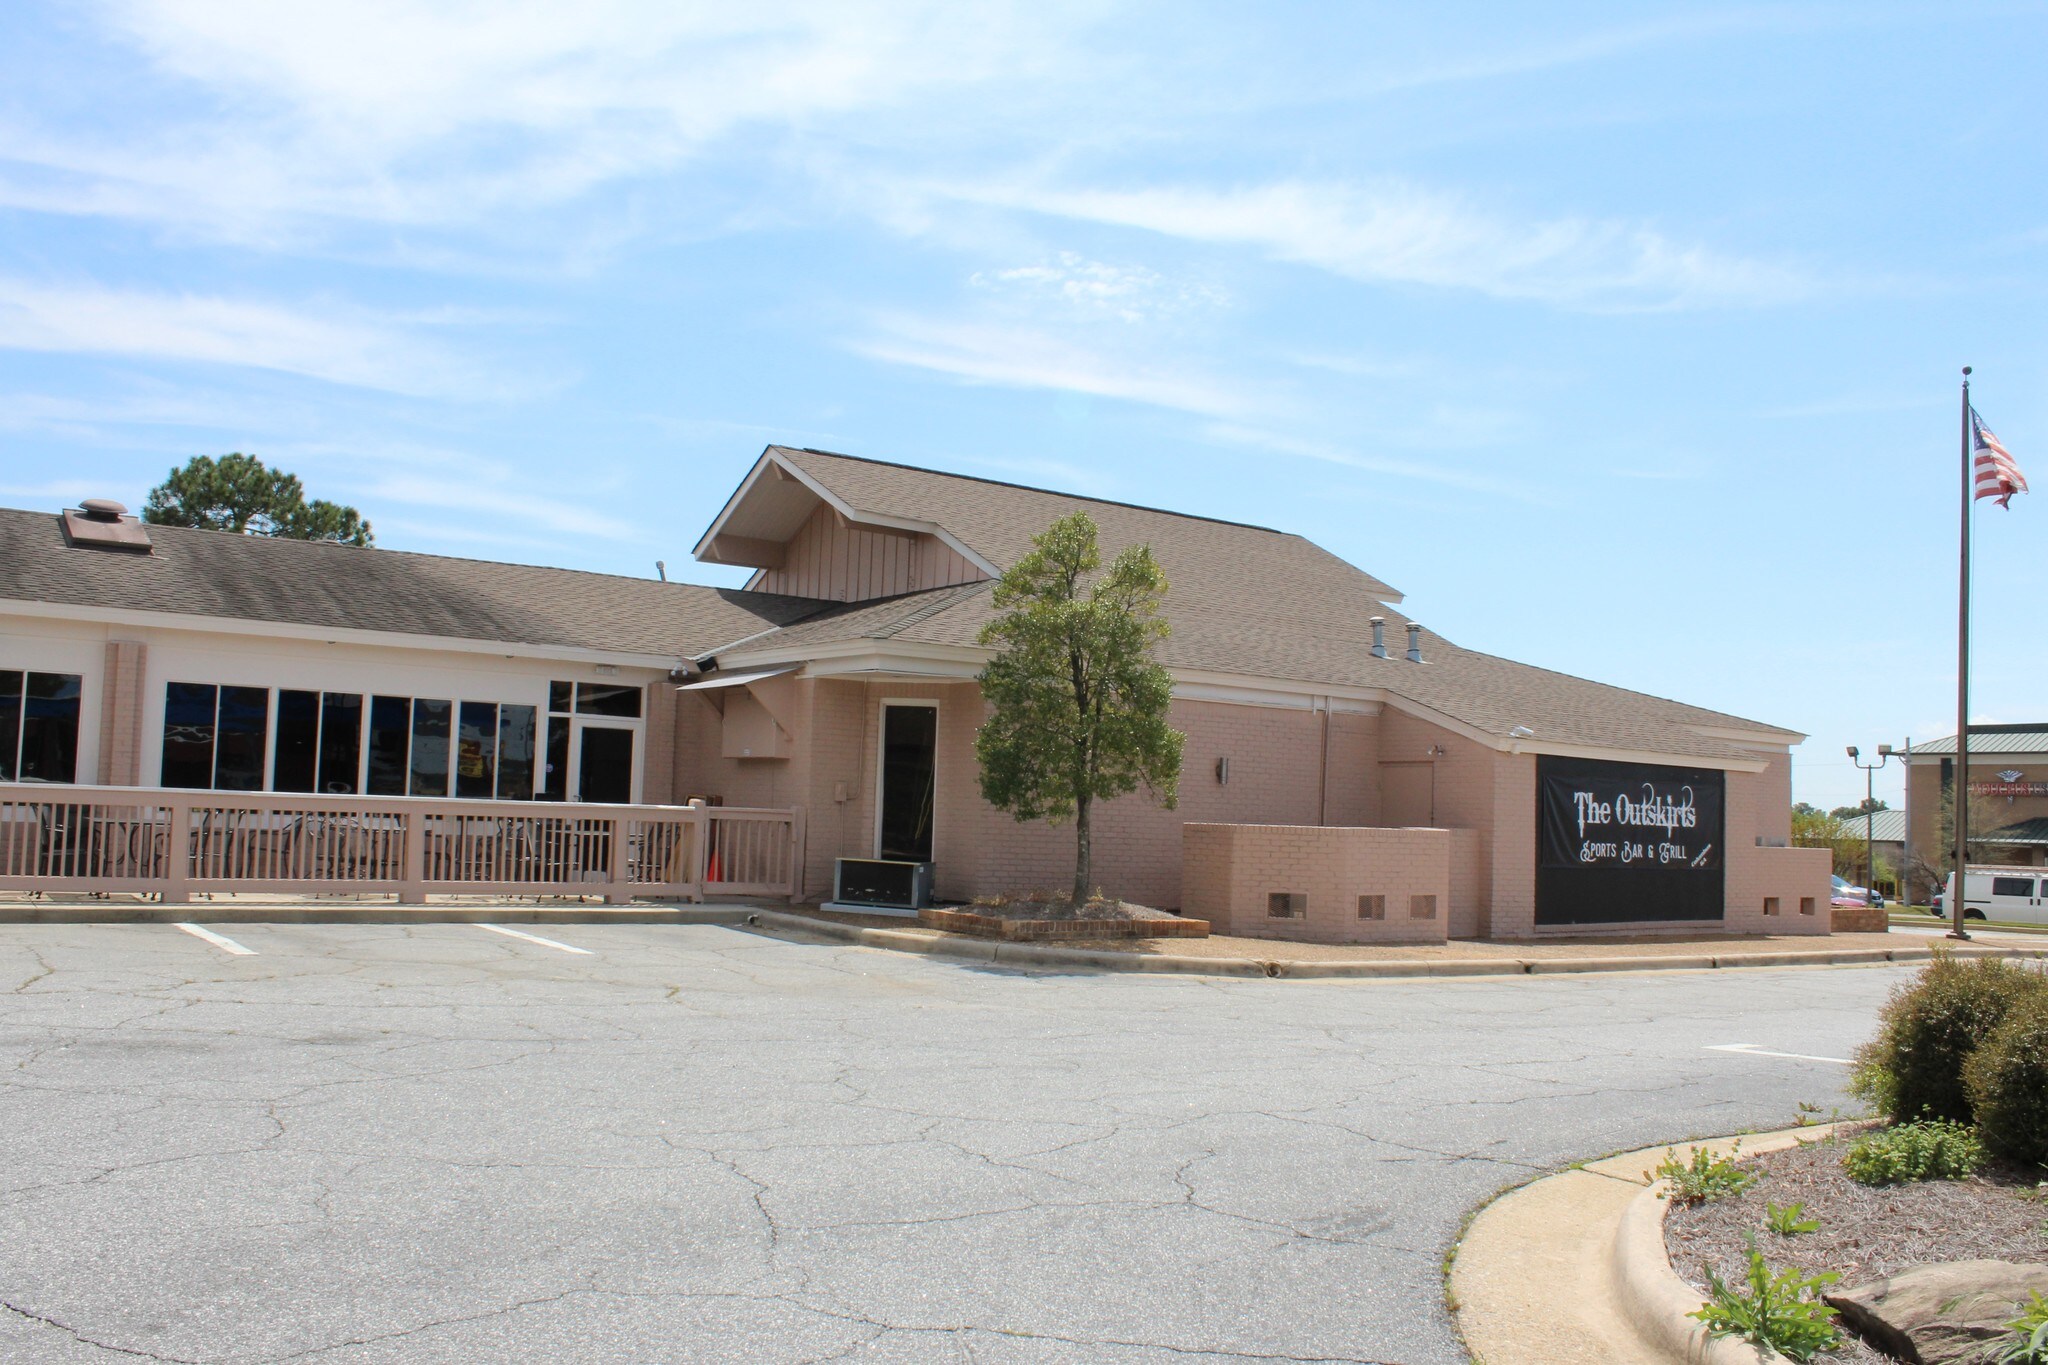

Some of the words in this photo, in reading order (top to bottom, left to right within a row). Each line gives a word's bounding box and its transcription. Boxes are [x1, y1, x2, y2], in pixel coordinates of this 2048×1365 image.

[1573, 791, 1611, 839] The
[1615, 782, 1697, 839] Outskirts
[1648, 844, 1654, 859] &
